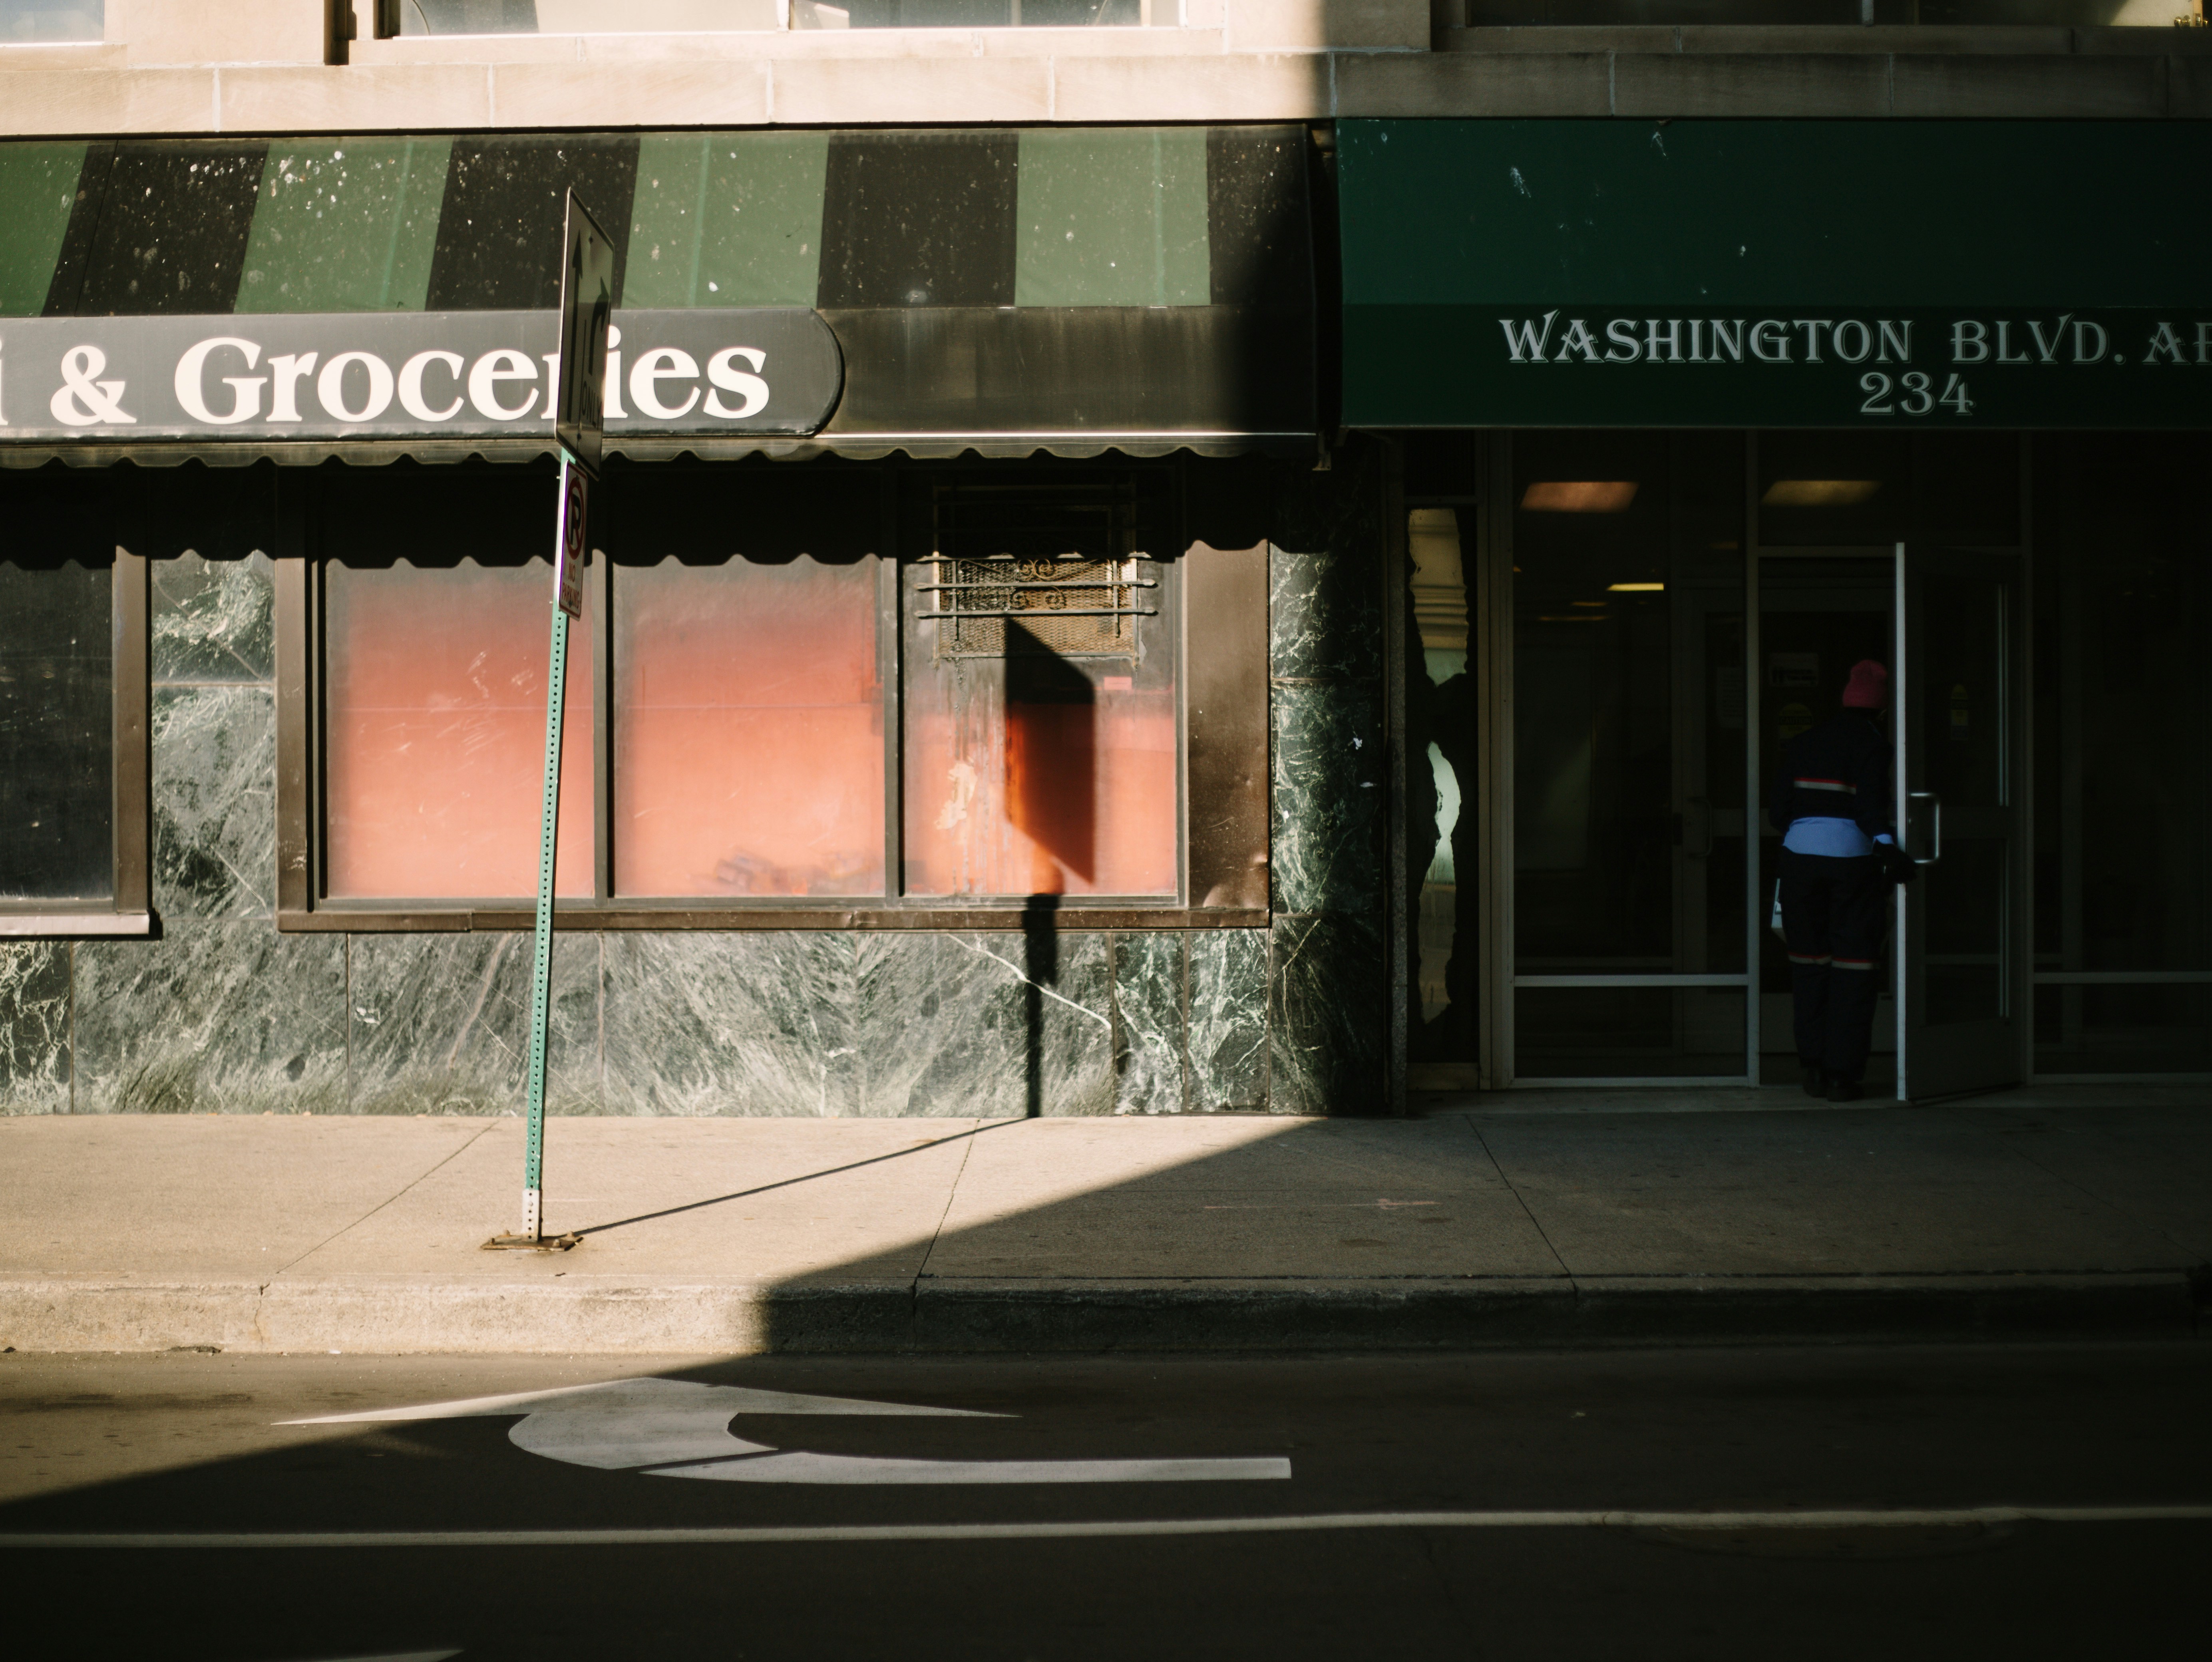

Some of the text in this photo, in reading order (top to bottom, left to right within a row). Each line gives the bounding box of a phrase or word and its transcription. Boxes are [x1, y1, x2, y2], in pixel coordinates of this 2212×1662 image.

[1498, 309, 1916, 364] WASHINGTON
[1950, 312, 2126, 364] BLVD.
[50, 345, 137, 426] &
[581, 381, 603, 431] ONLY
[1859, 372, 1976, 416] 234
[561, 582, 580, 609] PARKING
[568, 562, 575, 582] NO
